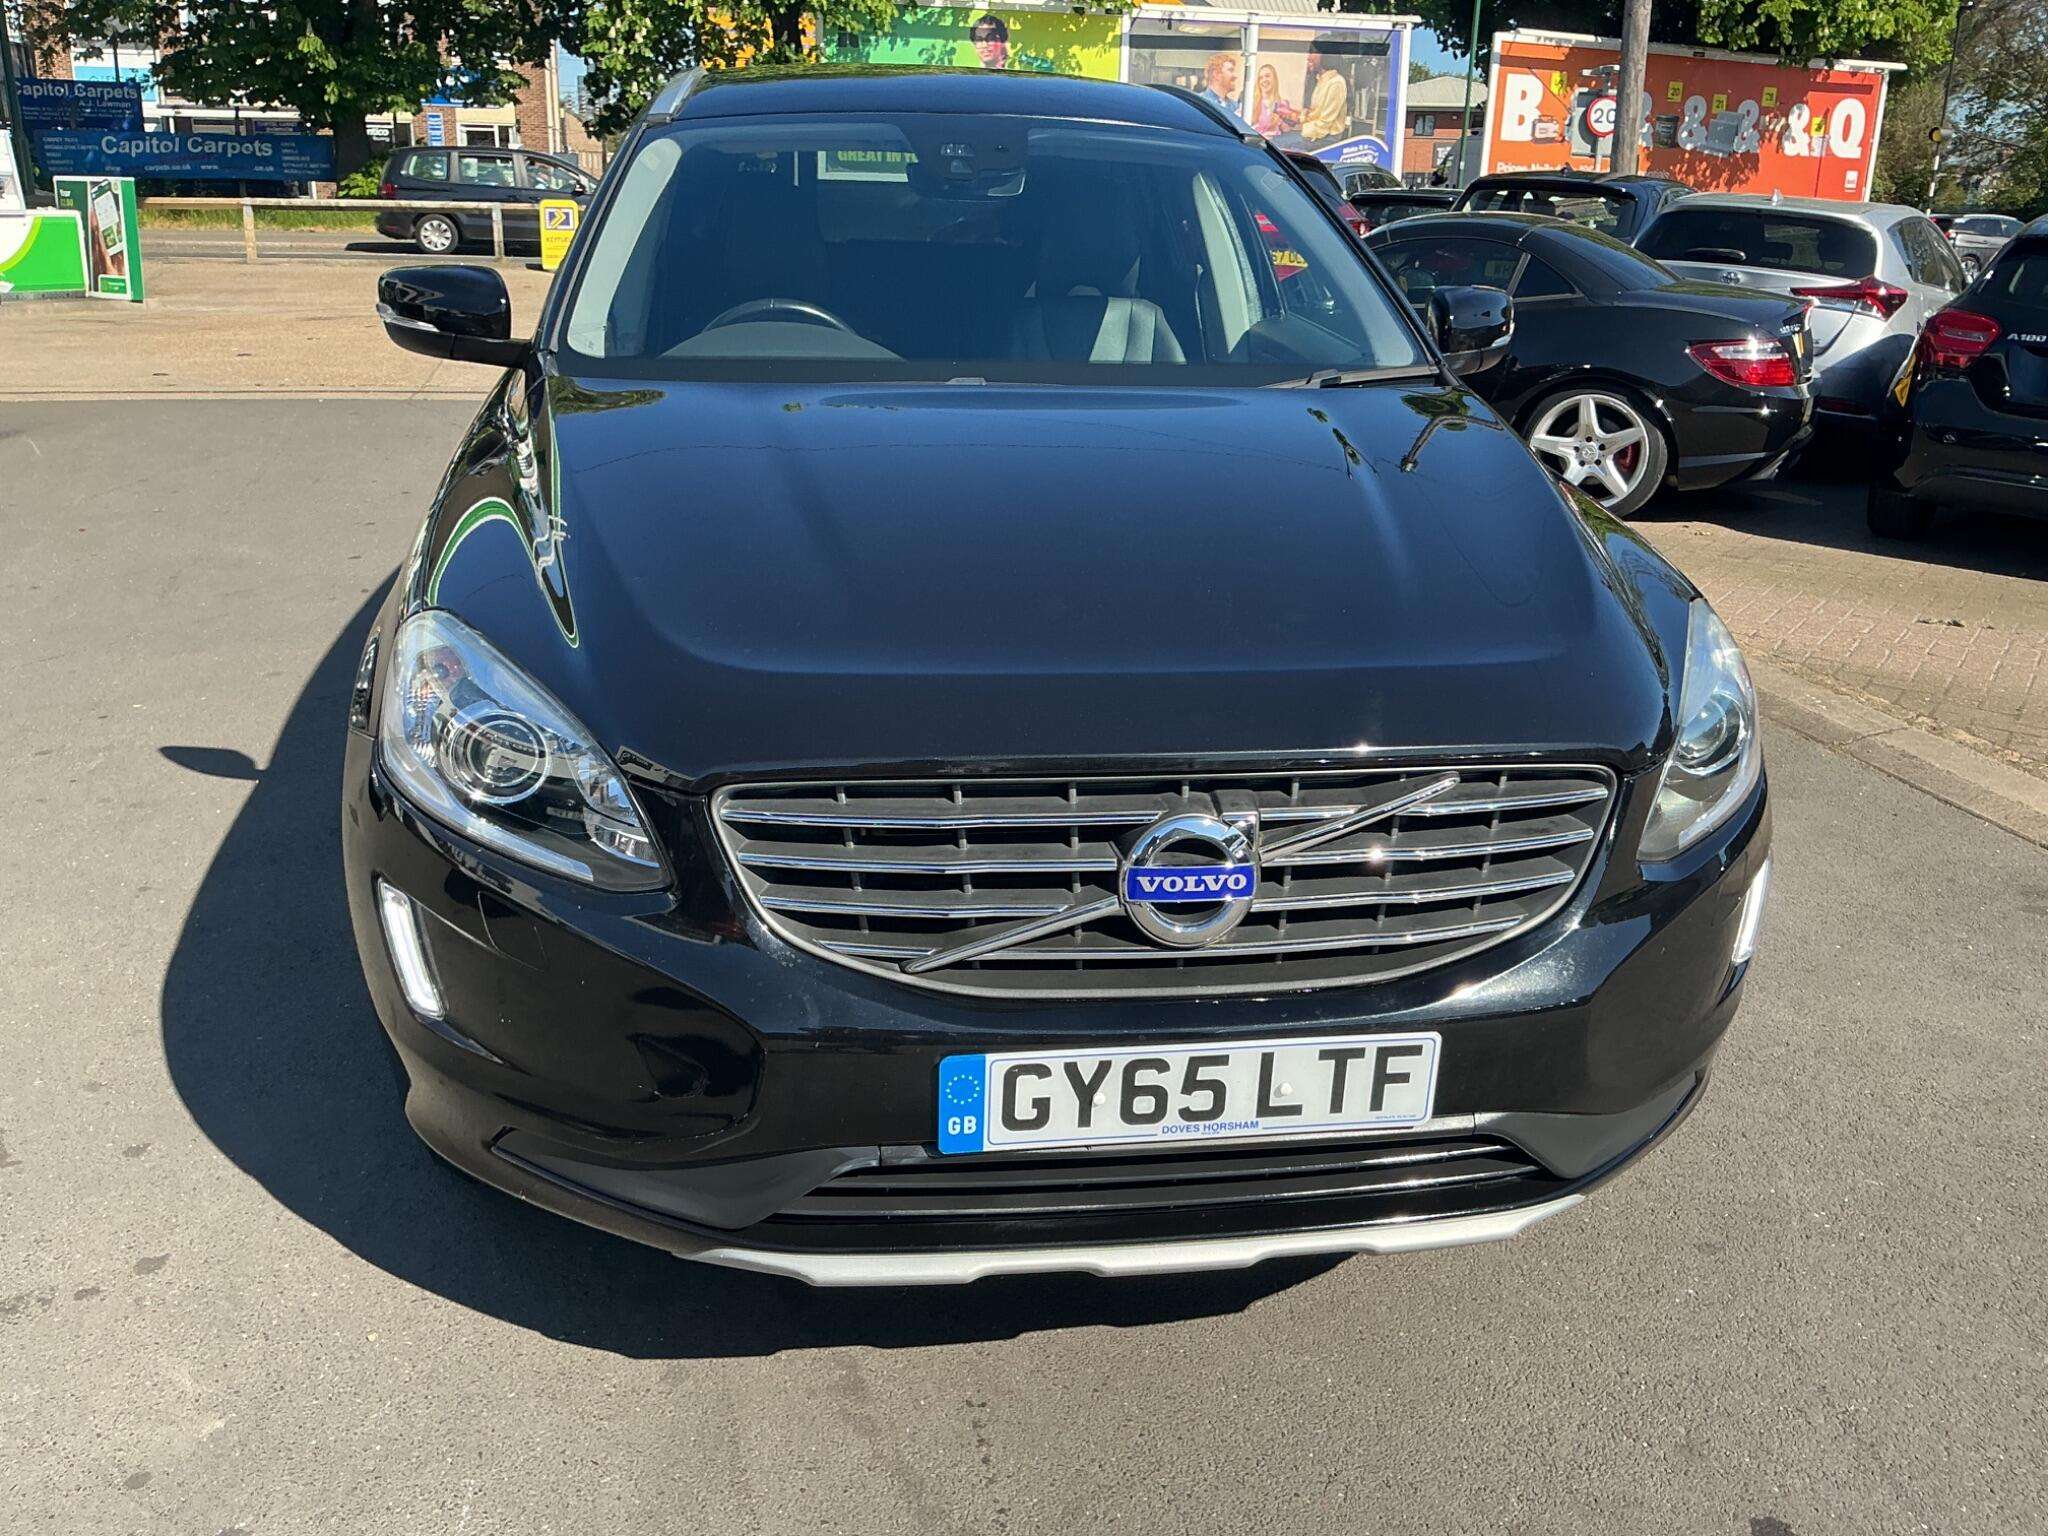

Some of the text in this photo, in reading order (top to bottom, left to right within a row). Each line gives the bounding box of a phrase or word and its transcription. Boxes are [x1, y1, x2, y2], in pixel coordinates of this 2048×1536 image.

[74, 83, 138, 100] Carpets
[1593, 107, 1616, 124] 20
[1829, 97, 1866, 159] Q
[101, 136, 273, 157] Capitol Carpets
[1136, 874, 1248, 893] VOLVO
[1001, 1044, 1424, 1132] GY65 LTF
[947, 1115, 977, 1136] GB
[1161, 1120, 1260, 1135] DOVES HORSHAM
